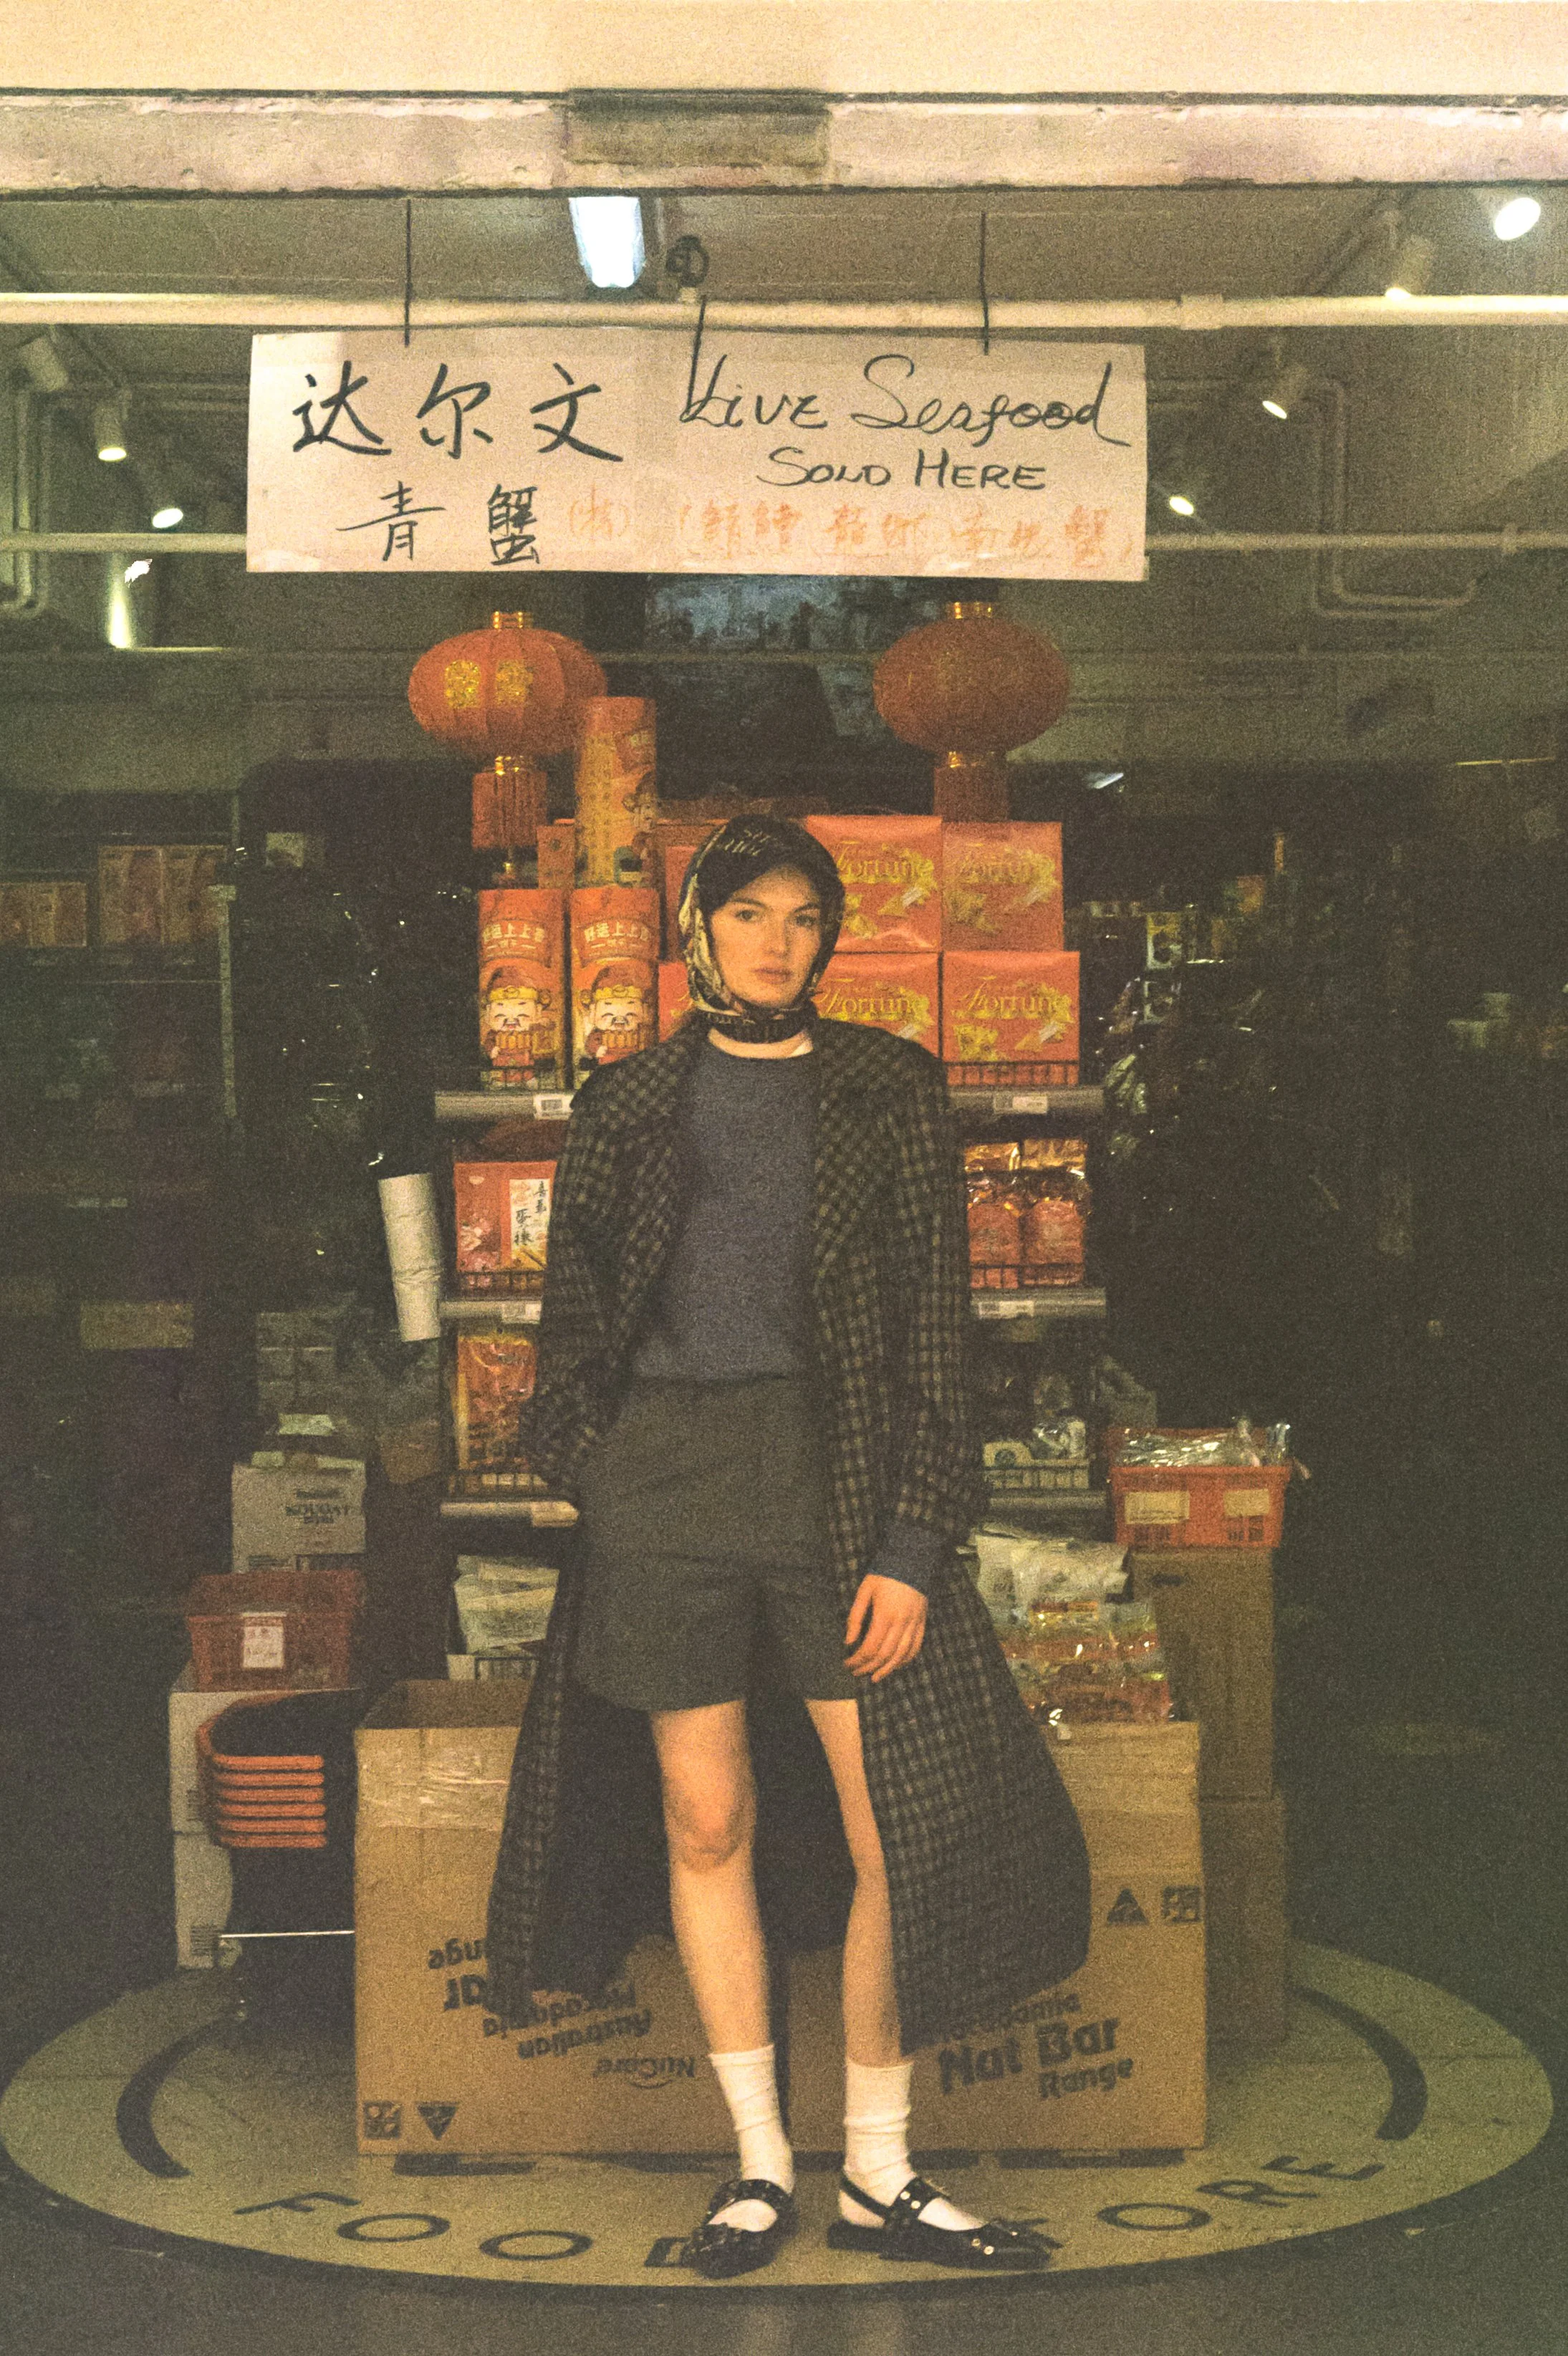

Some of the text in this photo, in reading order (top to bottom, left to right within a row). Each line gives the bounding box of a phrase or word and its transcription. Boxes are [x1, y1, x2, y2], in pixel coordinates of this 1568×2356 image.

[292, 360, 624, 462] 达尔文
[850, 354, 1132, 448] Seafood
[1034, 2018, 1120, 2069] Bar
[1038, 2057, 1134, 2100] Range
